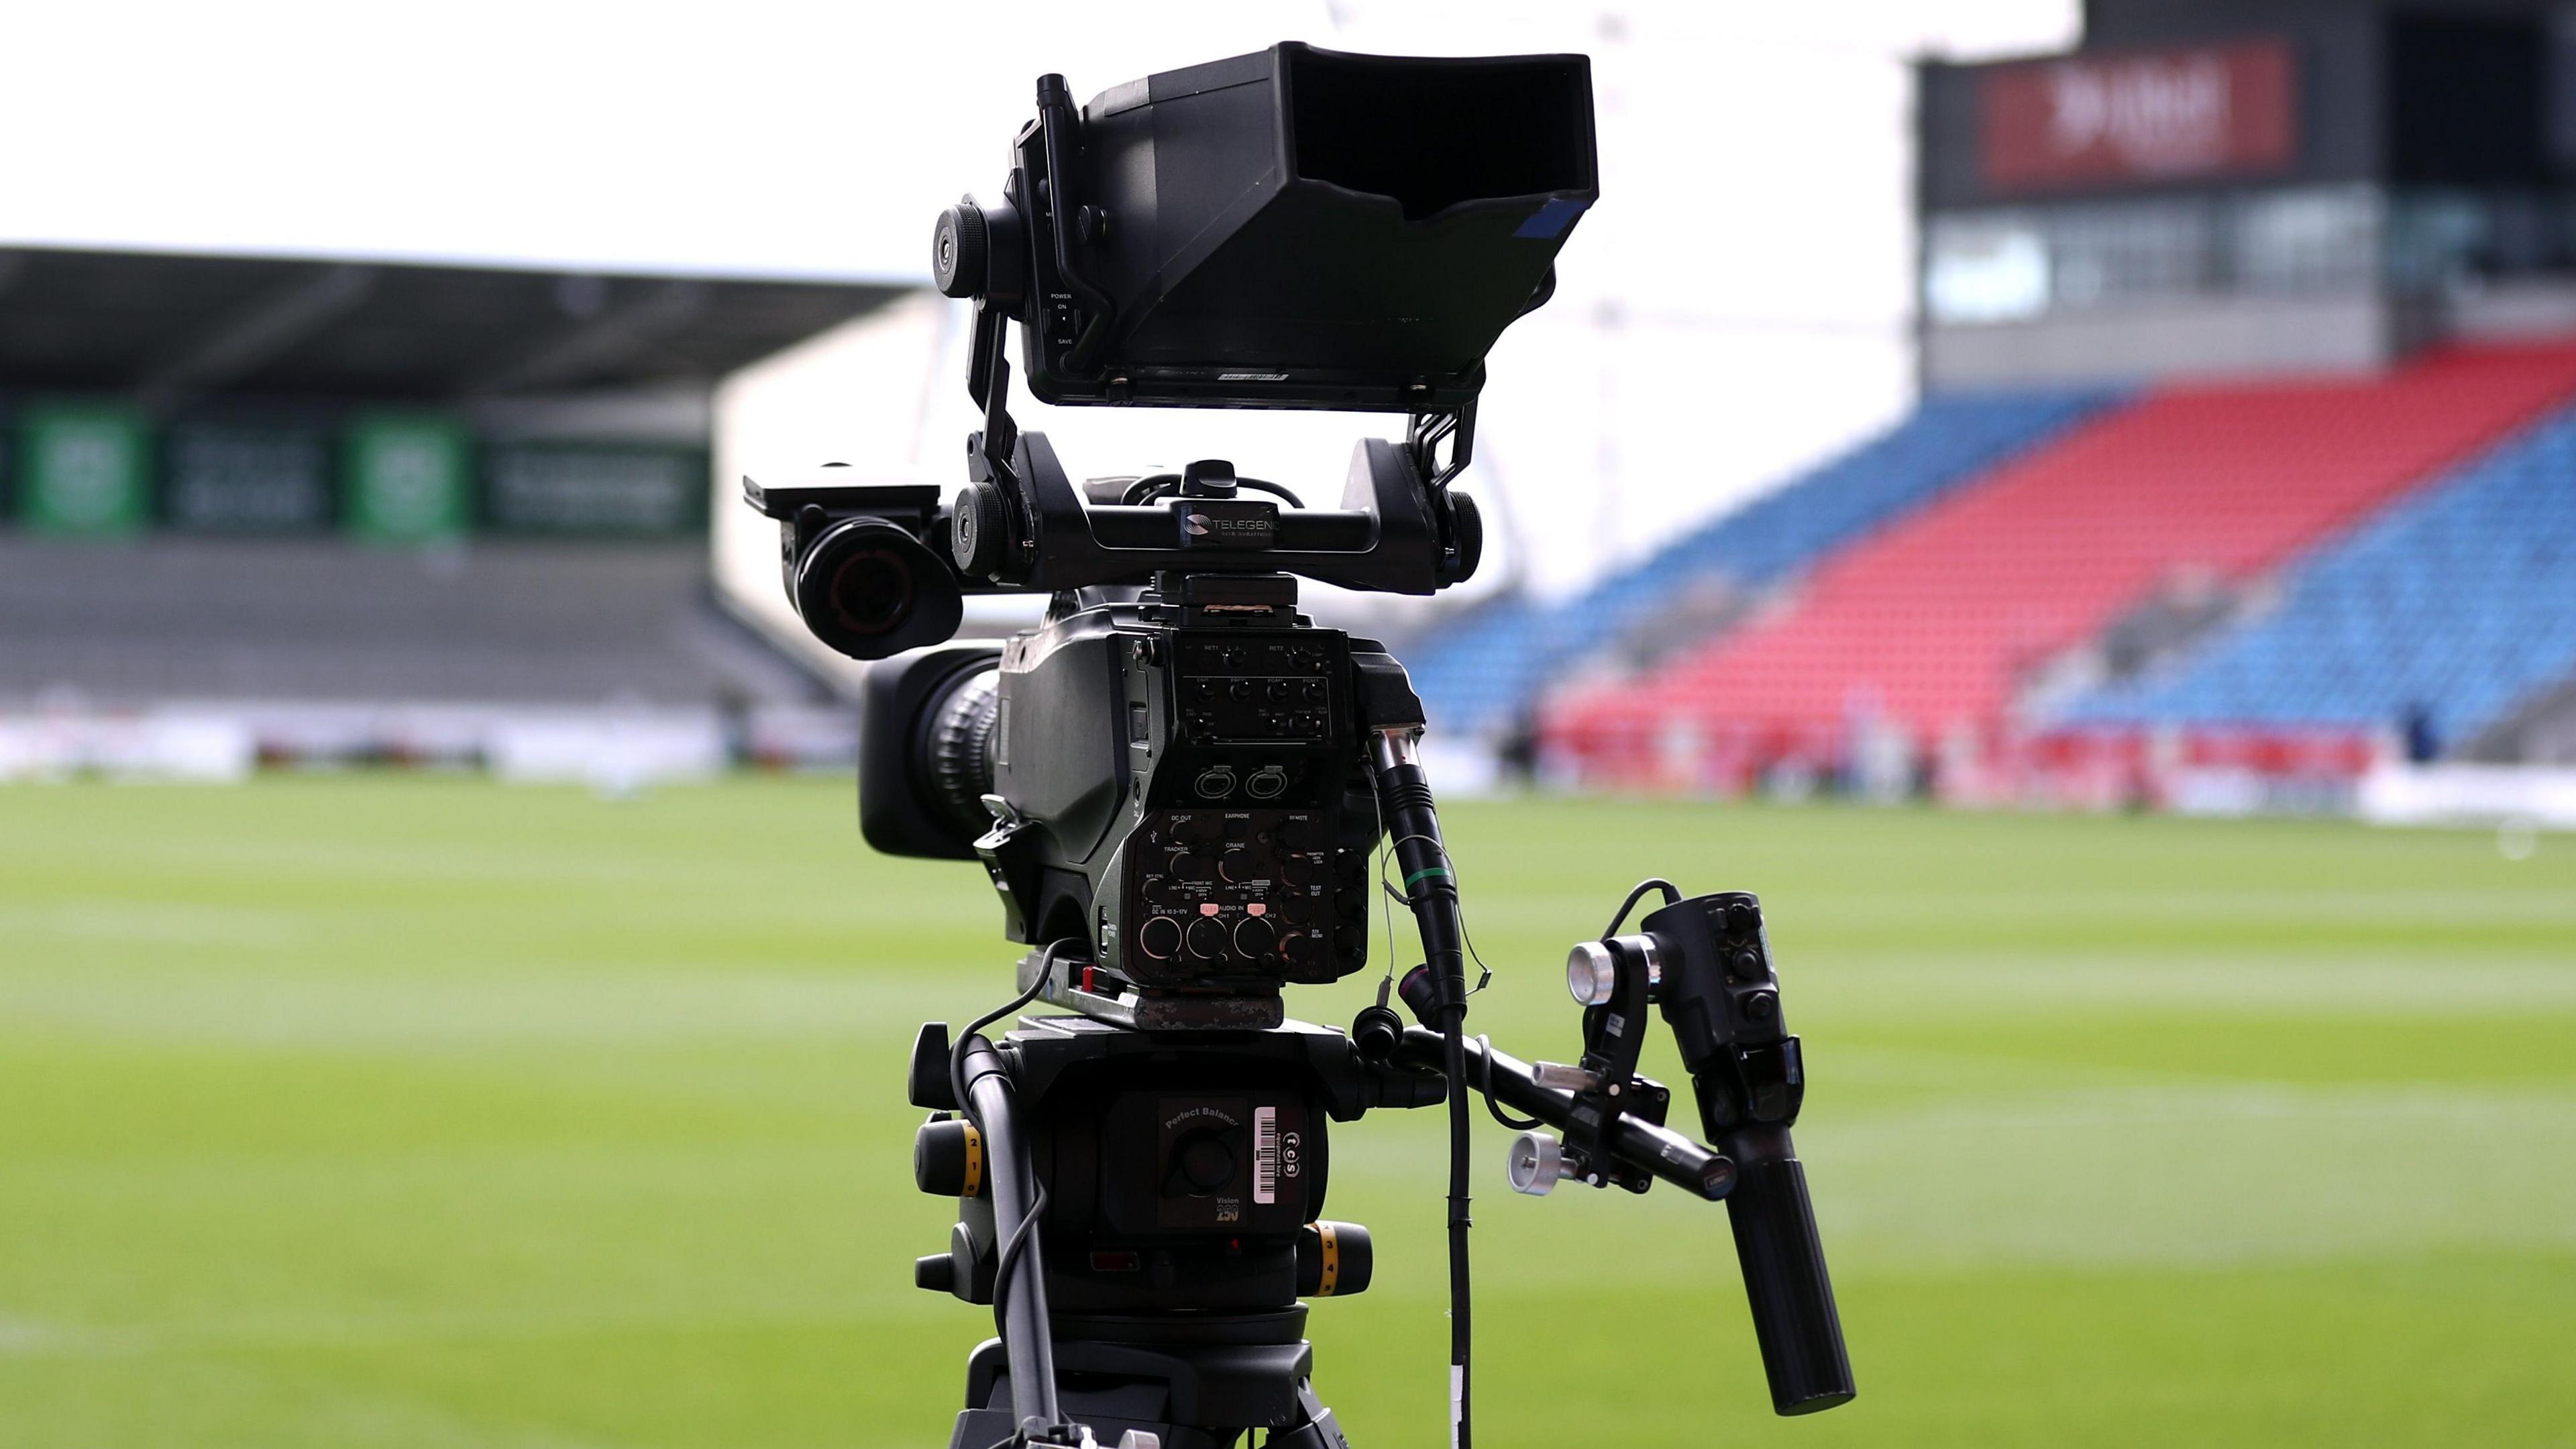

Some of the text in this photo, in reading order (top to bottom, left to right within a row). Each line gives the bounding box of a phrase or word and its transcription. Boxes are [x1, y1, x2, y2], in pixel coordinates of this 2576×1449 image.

[1165, 1108, 1199, 1129] Perfect
[970, 1138, 977, 1146] 2
[971, 1162, 977, 1170] 1
[1216, 1204, 1239, 1222] 250
[1326, 1240, 1333, 1248] 3
[1327, 1264, 1334, 1272] 4
